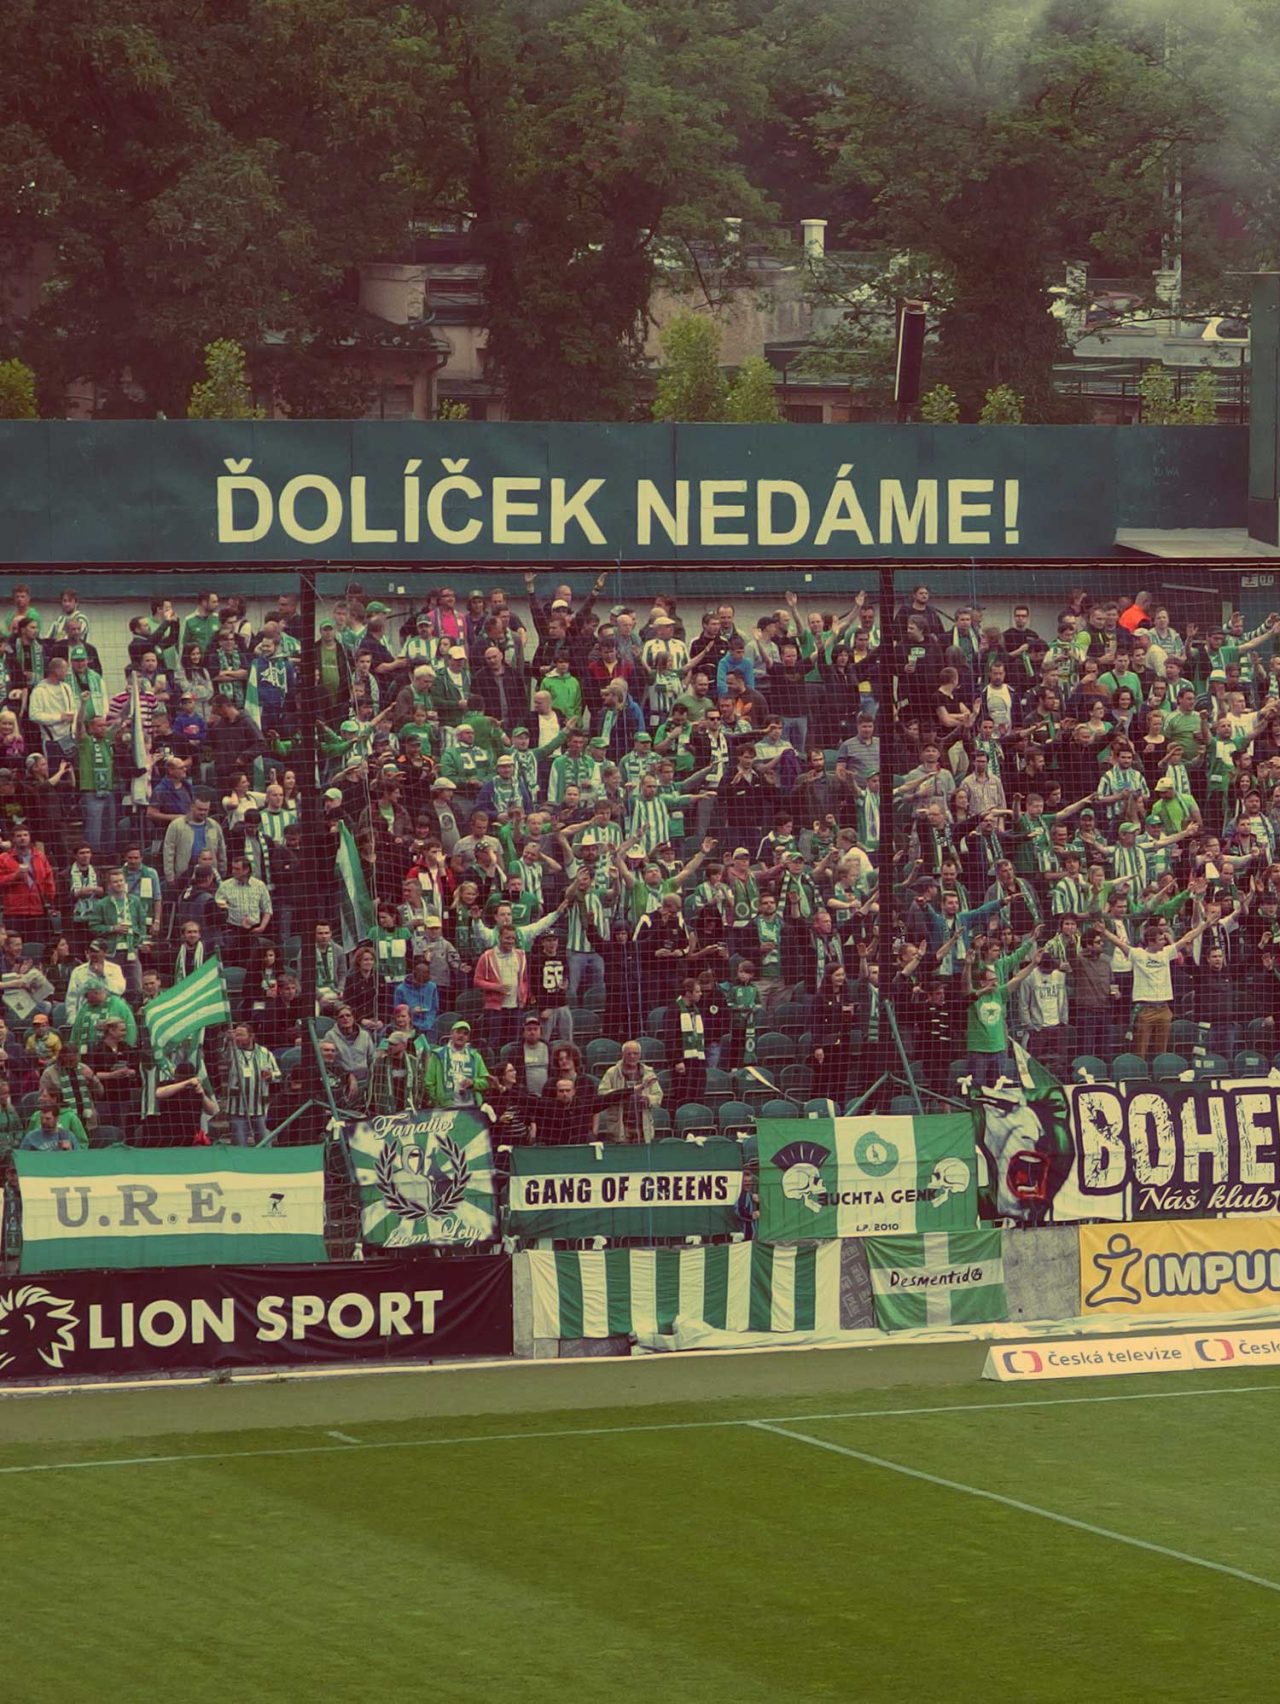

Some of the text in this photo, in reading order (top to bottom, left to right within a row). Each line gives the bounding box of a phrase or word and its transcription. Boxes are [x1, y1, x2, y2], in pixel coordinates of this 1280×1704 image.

[216, 458, 1020, 546] ĎOLÍČEK NEDÁME!
[372, 1113, 455, 1140] Fanatics
[50, 1182, 242, 1228] U.R.E.
[525, 1175, 729, 1205] GANG OF GREENS
[1139, 1187, 1200, 1211] Náš
[1206, 1181, 1272, 1209] klub
[874, 1223, 899, 1231] 2010
[88, 1289, 444, 1350] LION SPORT
[1047, 1346, 1182, 1367] Česká televize
